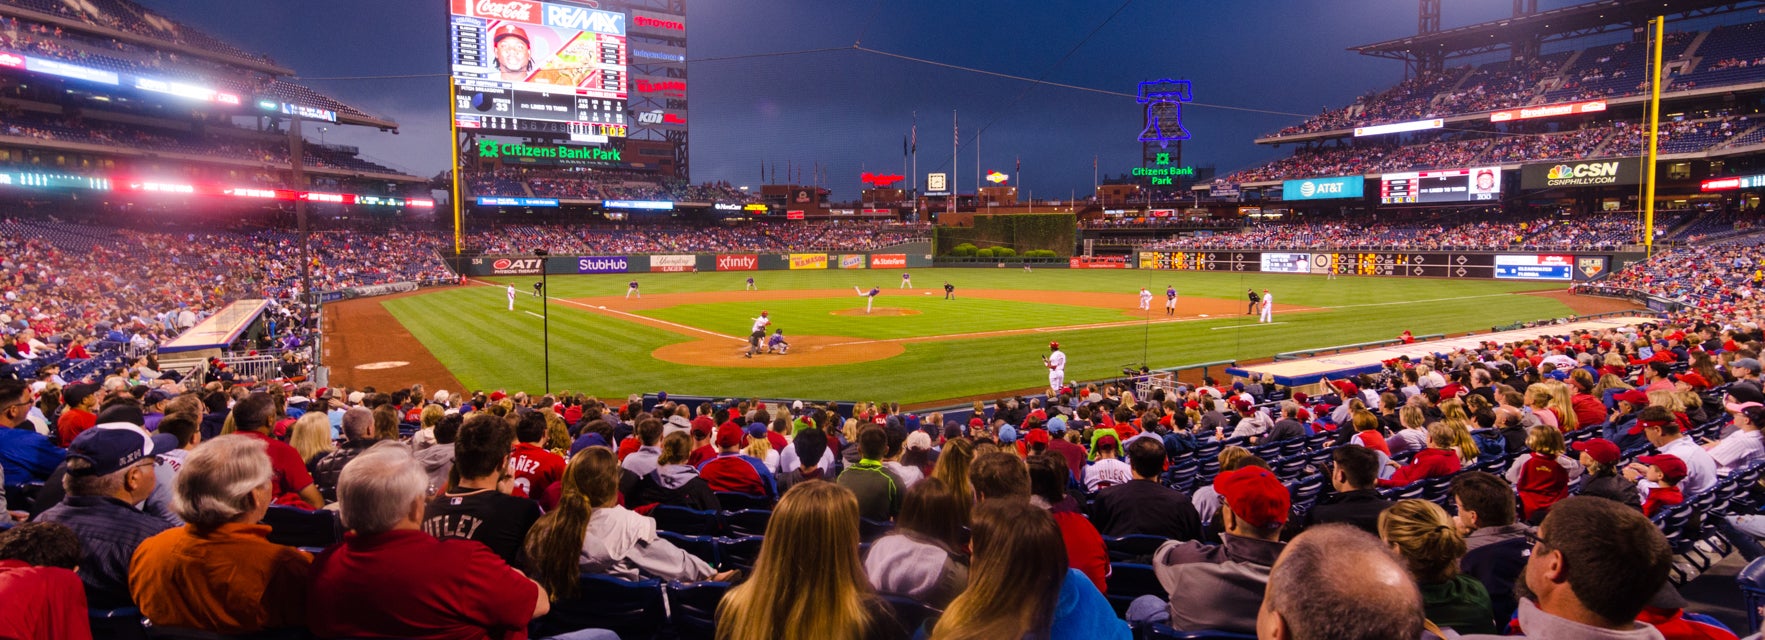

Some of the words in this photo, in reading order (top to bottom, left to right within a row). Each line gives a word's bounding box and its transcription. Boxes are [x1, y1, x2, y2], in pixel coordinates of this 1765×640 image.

[476, 0, 533, 21] Coca-Cola
[548, 6, 620, 33] RE/MAX
[647, 19, 685, 31] TOYOTA
[618, 128, 625, 137] 2
[501, 144, 557, 158] Citizens
[558, 146, 591, 159] Bank
[593, 148, 621, 161] Park
[1132, 167, 1169, 176] Citizens
[1169, 166, 1193, 175] Bank
[1573, 162, 1619, 178] CSN
[1151, 176, 1173, 185] Park
[1547, 177, 1616, 186] CSNPHILLY.COM
[1316, 182, 1344, 194] AT&T
[510, 259, 543, 269] ATI
[579, 259, 628, 270] StubHub
[719, 256, 756, 270] xfinity
[510, 455, 540, 475] AÑEZ
[1099, 468, 1125, 481] GILES
